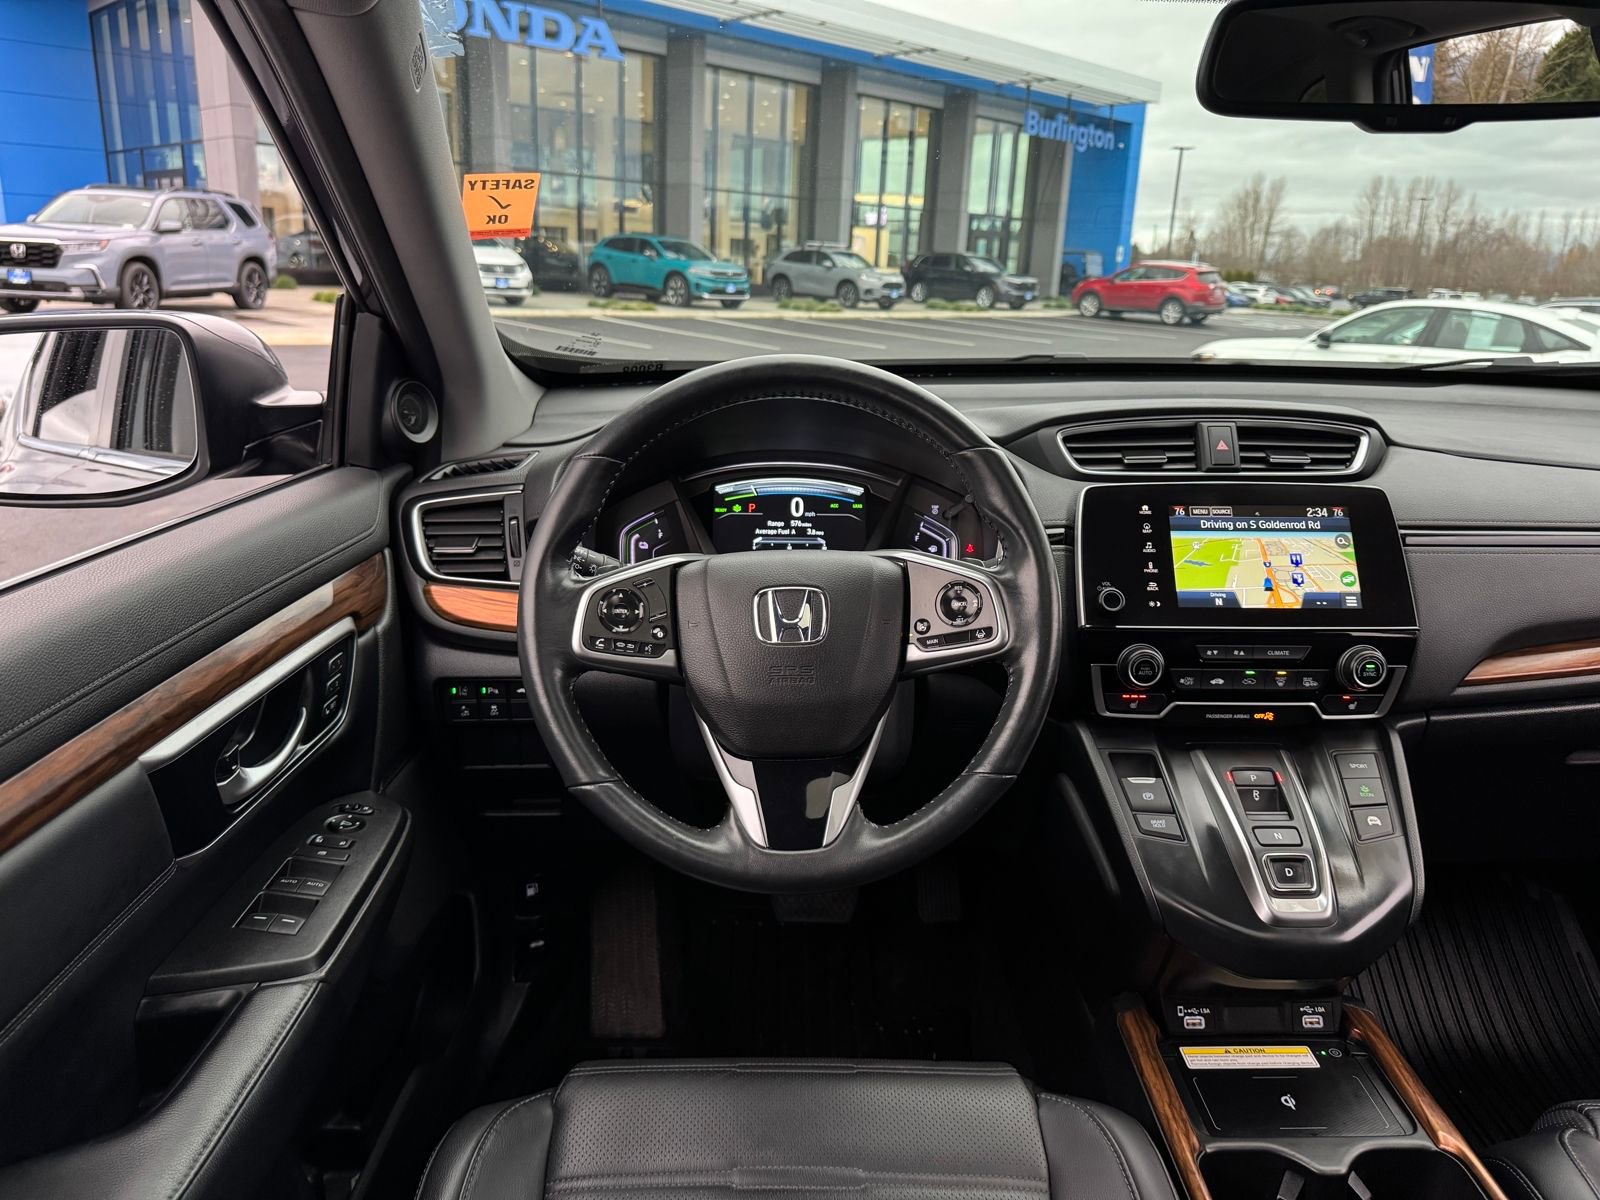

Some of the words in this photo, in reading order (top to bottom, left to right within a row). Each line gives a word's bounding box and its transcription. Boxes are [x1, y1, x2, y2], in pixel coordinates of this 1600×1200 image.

[1024, 109, 1114, 152] Burlington
[748, 503, 757, 513] P
[790, 497, 805, 517] 0
[1174, 507, 1185, 516] 76
[1306, 507, 1328, 517] 2:34
[1332, 508, 1343, 516] 76
[767, 520, 785, 528] Range
[1200, 520, 1233, 531] Driving
[1250, 520, 1257, 529] S
[1258, 520, 1306, 529] Goldenrod
[1308, 520, 1321, 529] Rd
[755, 528, 777, 536] Average
[1215, 598, 1223, 606] N
[769, 666, 815, 675] SRS
[1249, 774, 1257, 782] P
[1253, 790, 1260, 798] R
[1274, 832, 1282, 840] N
[1285, 868, 1294, 877] D
